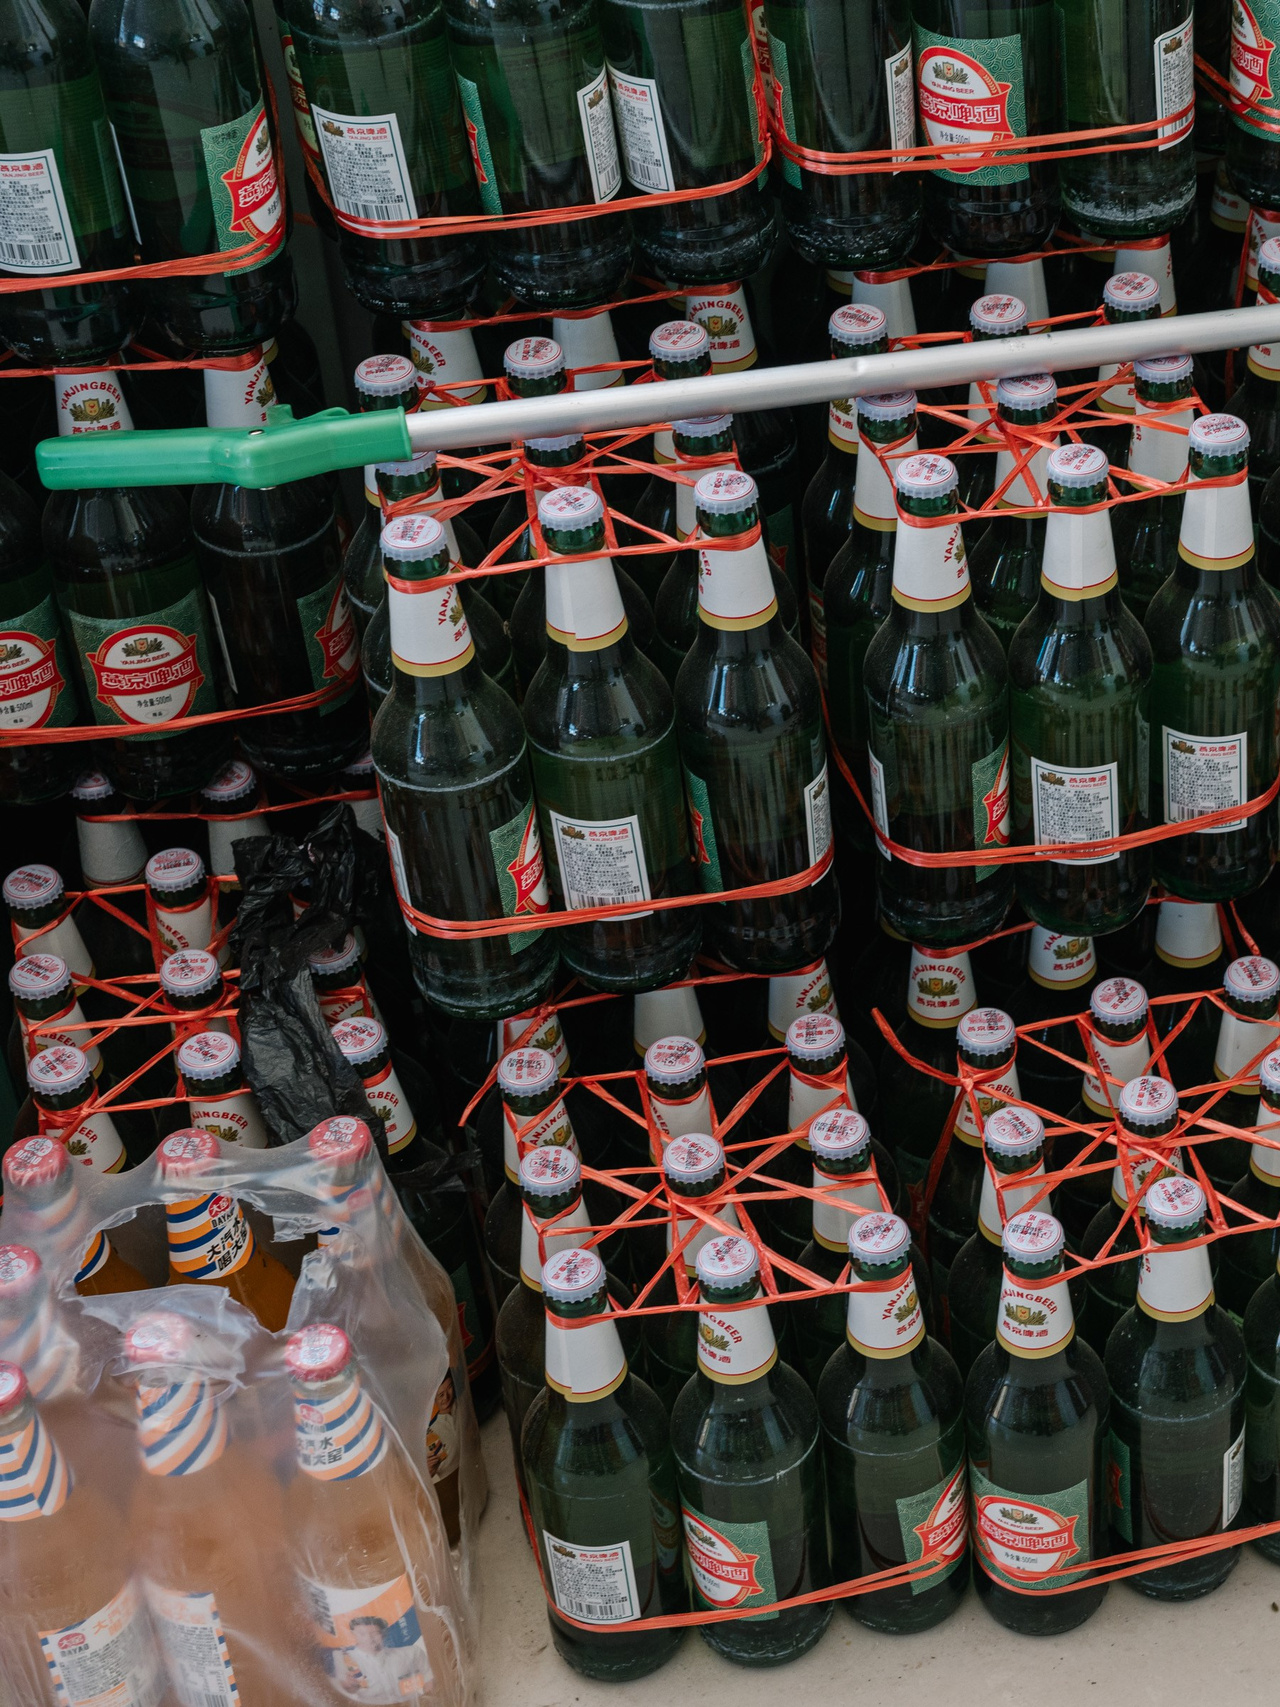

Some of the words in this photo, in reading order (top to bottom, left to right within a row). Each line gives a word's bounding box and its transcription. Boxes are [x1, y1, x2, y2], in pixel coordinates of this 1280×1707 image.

[955, 86, 975, 95] BEER
[60, 381, 121, 412] YANJINGBEER
[152, 652, 171, 662] BEER
[101, 656, 194, 690] 燕京啤酒
[136, 694, 172, 708] 净含量:500ml
[911, 964, 967, 984] YANJINGBEER
